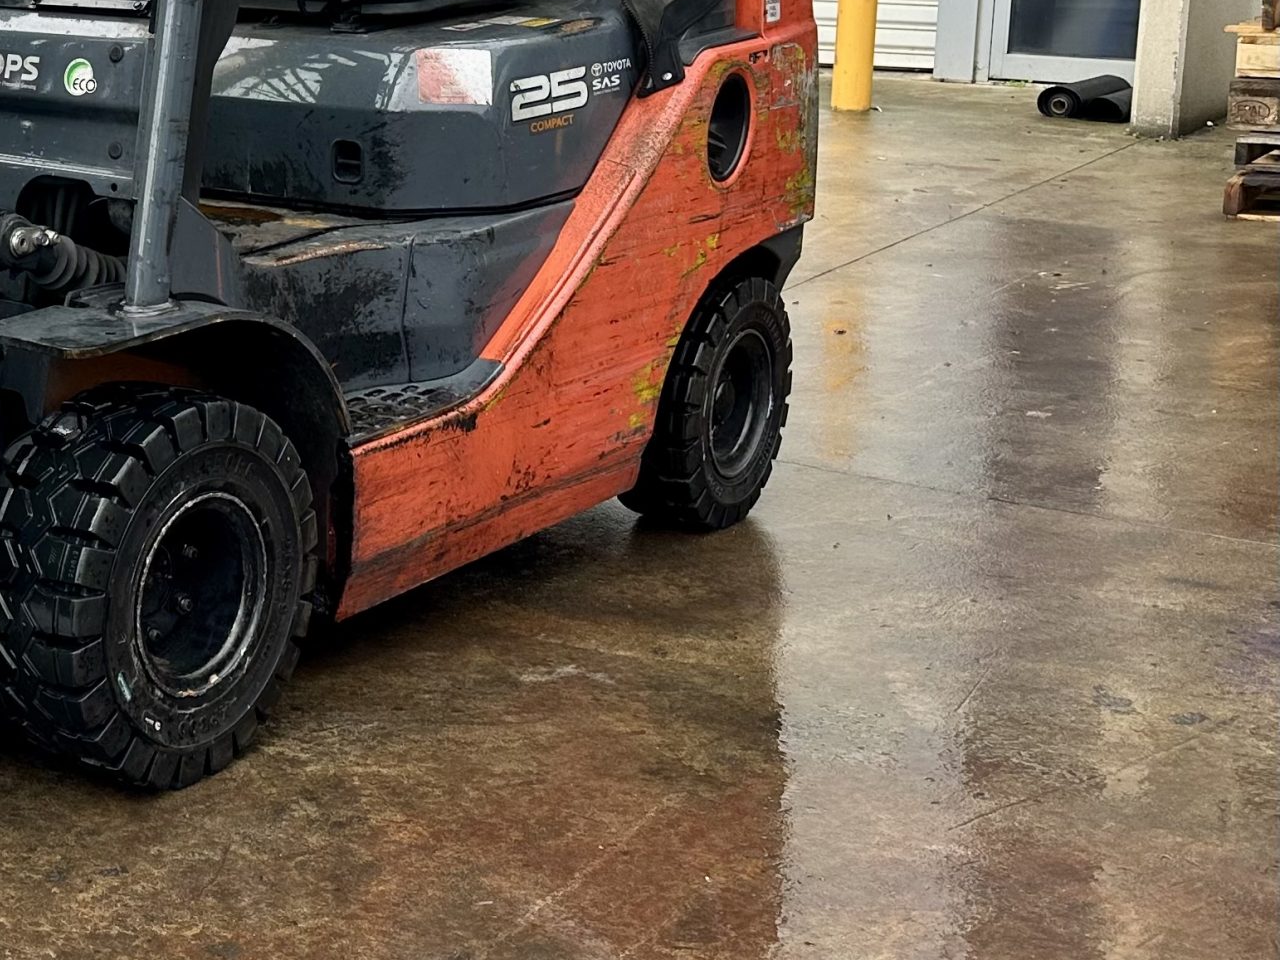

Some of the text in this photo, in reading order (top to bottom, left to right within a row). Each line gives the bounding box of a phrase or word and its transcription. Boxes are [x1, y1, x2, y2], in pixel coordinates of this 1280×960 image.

[602, 58, 632, 73] TOYOTA
[592, 74, 620, 90] SAS
[510, 66, 588, 121] 25
[530, 114, 575, 132] COMPACT
